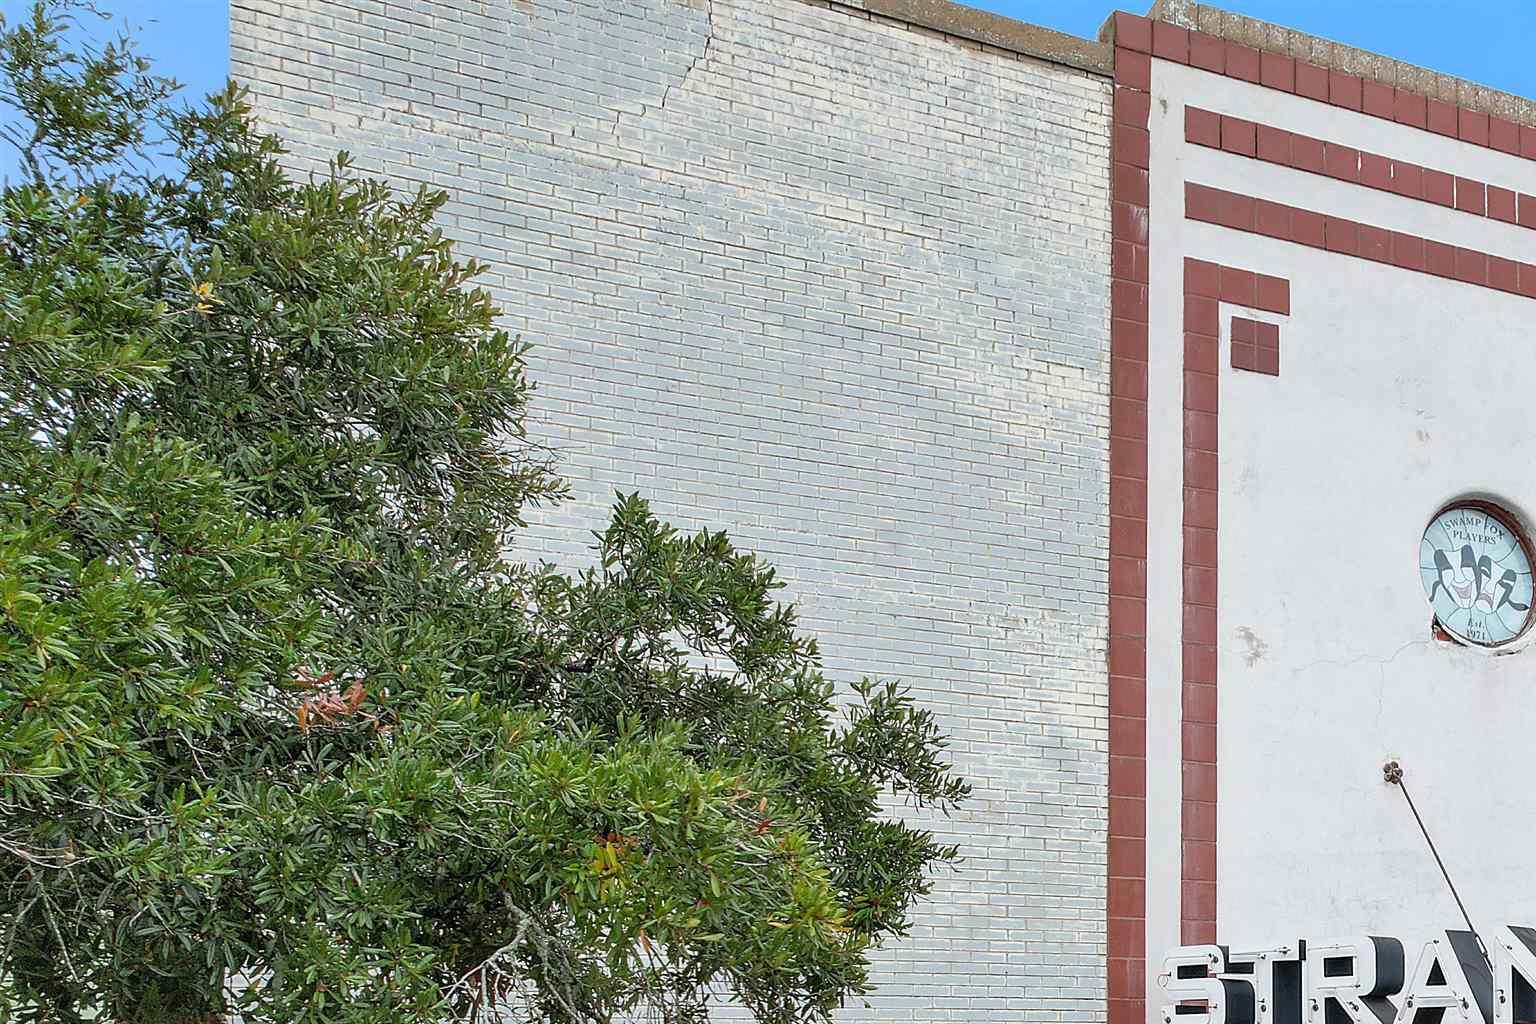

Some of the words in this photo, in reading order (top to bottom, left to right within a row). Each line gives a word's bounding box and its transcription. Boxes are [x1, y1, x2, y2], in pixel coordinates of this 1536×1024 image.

[1444, 517, 1482, 530] SWAMP
[1452, 530, 1497, 545] PLAYERS
[1466, 629, 1486, 640] 1971
